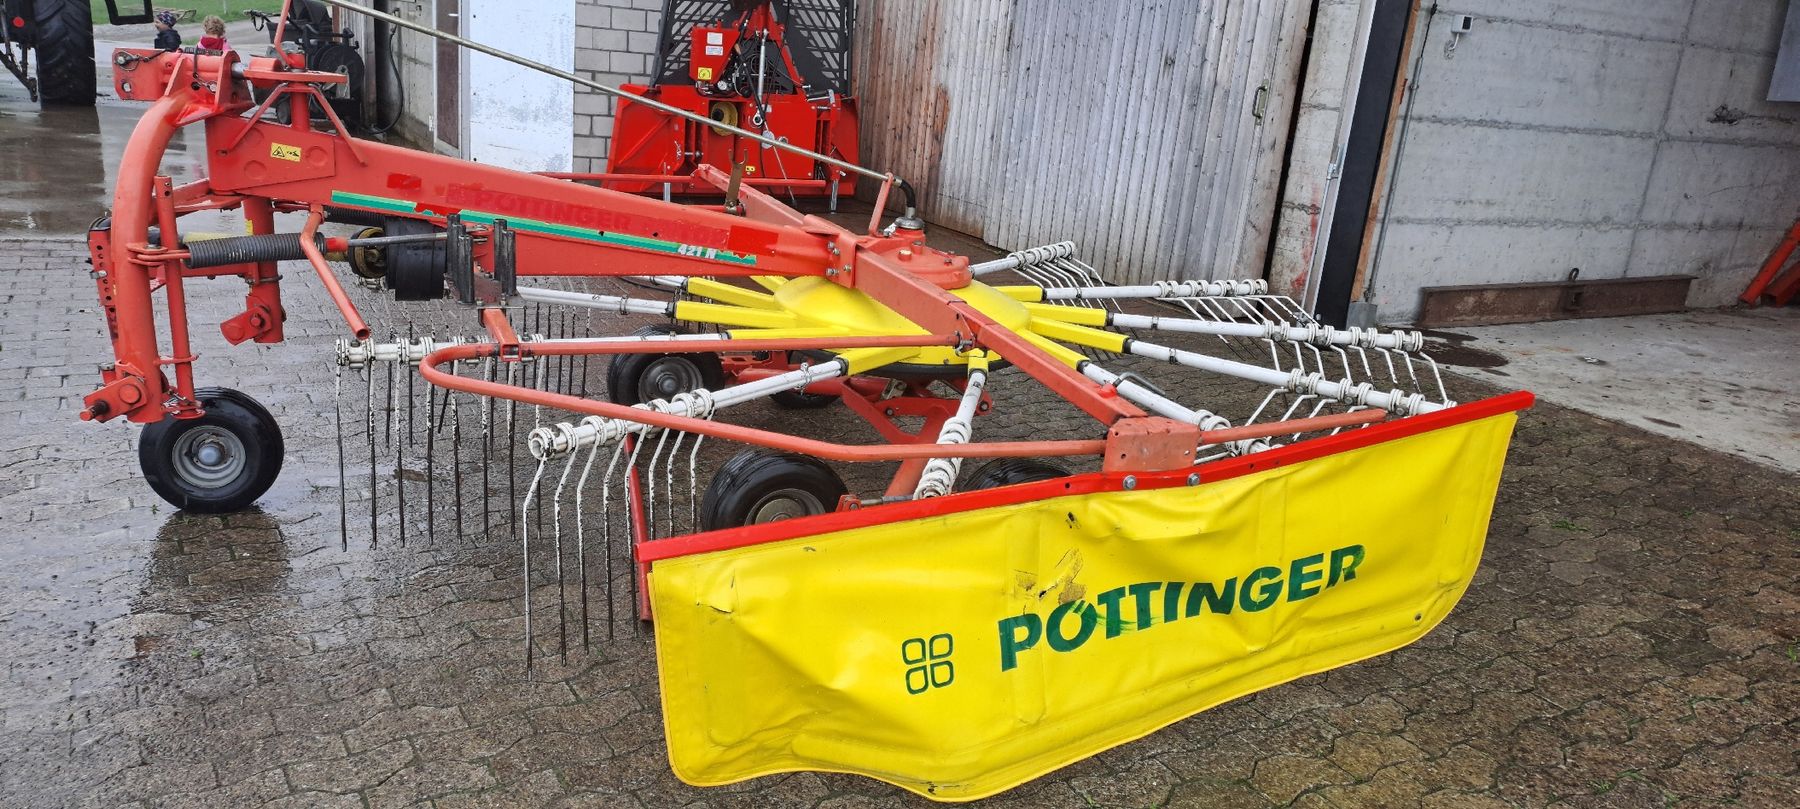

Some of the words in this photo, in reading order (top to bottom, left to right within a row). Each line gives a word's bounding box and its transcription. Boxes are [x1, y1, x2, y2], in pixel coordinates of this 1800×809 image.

[677, 243, 703, 257] 421
[704, 247, 718, 260] N
[998, 544, 1366, 672] PÖTTINGER
